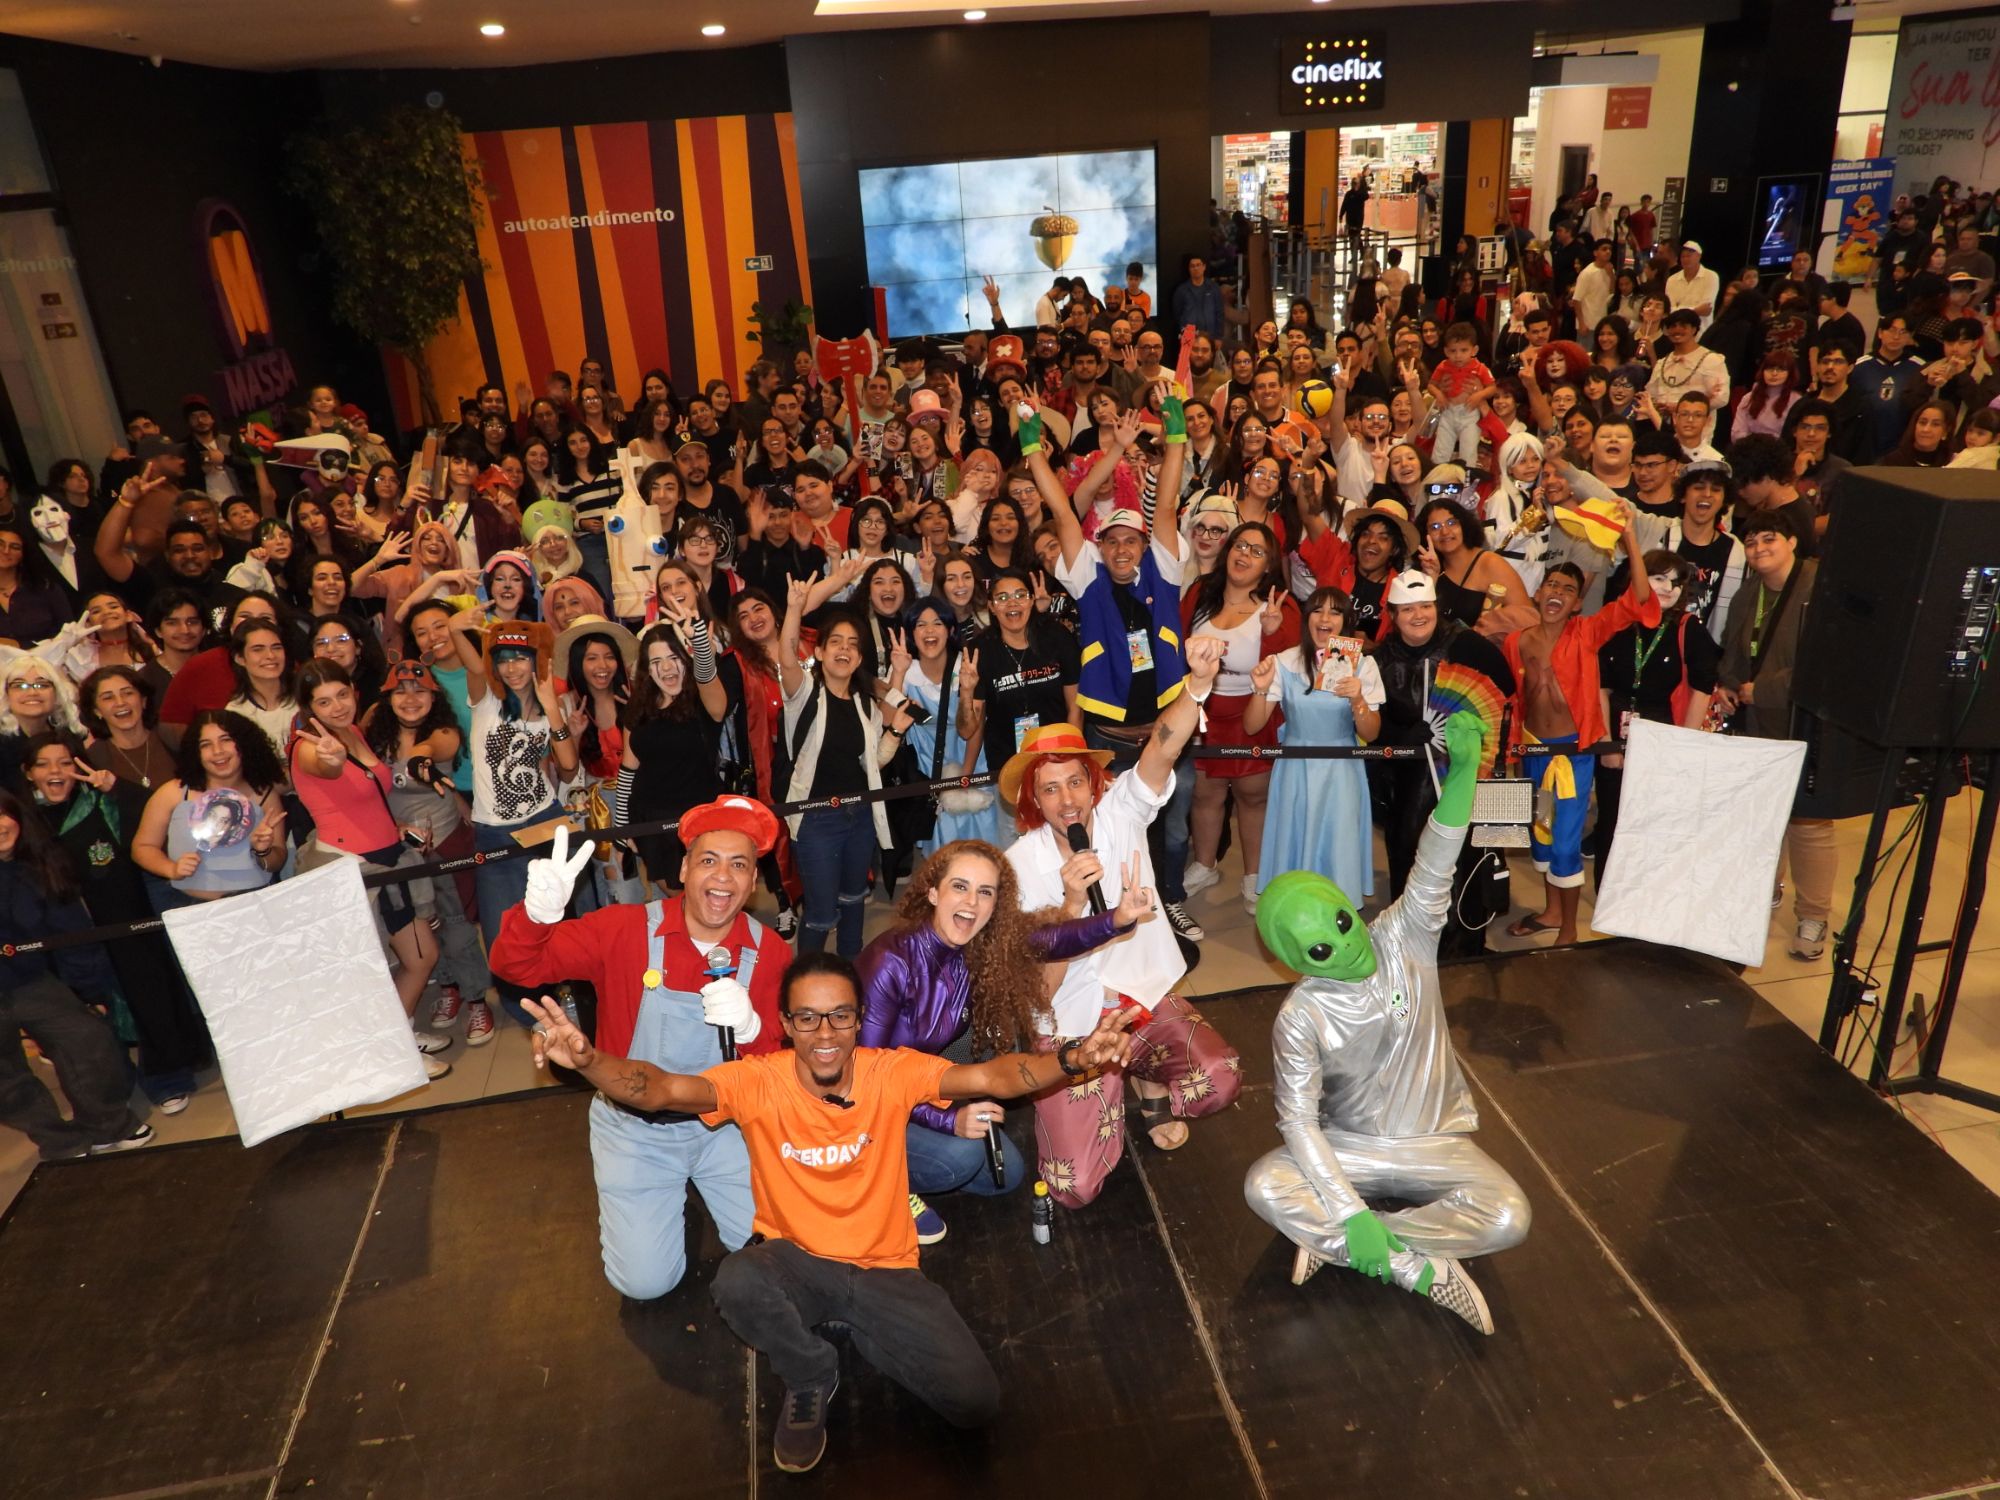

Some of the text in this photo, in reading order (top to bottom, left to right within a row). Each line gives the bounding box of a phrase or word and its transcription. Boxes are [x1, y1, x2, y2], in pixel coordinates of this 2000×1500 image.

[1930, 27, 1997, 45] IMAGINOU
[1967, 48, 1992, 62] TER
[1291, 58, 1383, 84] cineflix
[1899, 127, 1975, 142] NO SHOPPING
[1897, 144, 1943, 156] CIDADE?
[1835, 183, 1858, 194] GEEK
[504, 207, 675, 233] autoatendimento
[223, 347, 298, 418] MASSA
[929, 775, 991, 790] SHOPPING CIDADE
[798, 795, 862, 810] SHOPPING CIDADE
[439, 849, 509, 870] SHOPPING CIDADE
[16, 941, 43, 952] CIDADE
[781, 1142, 824, 1167] GEEK
